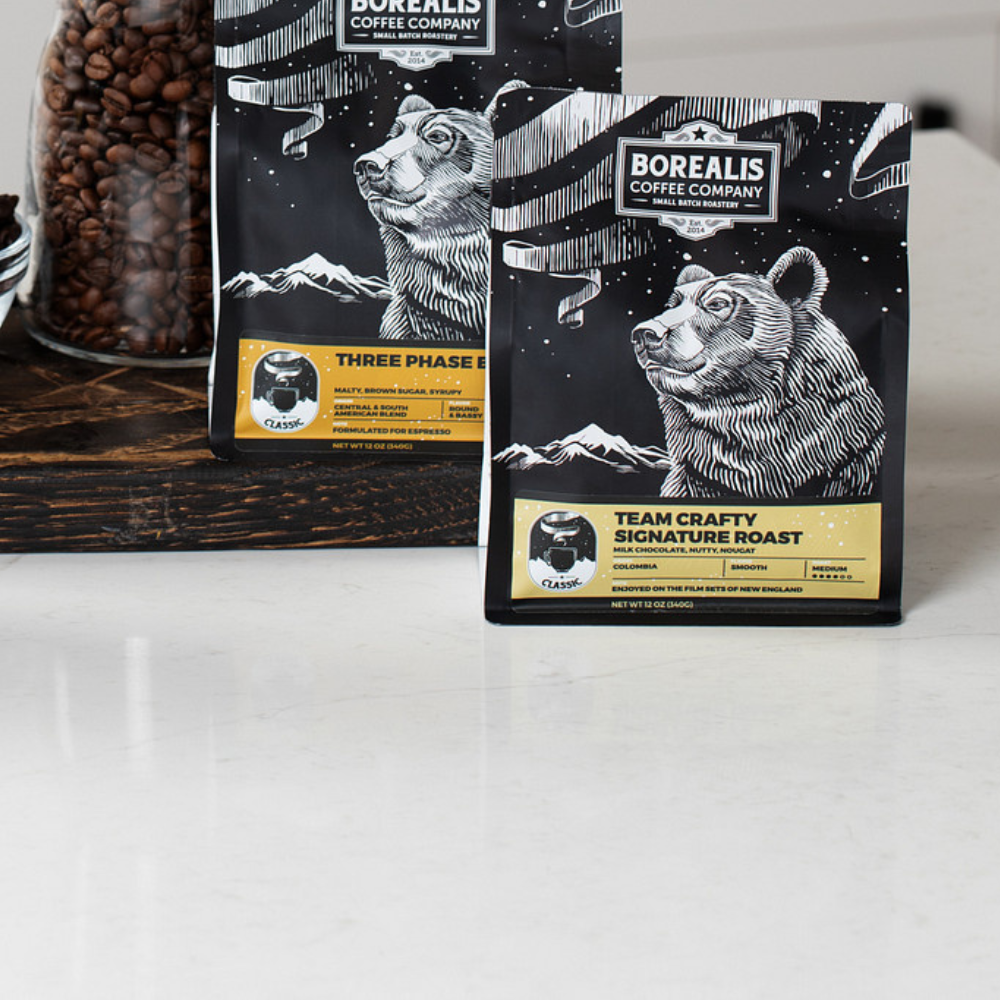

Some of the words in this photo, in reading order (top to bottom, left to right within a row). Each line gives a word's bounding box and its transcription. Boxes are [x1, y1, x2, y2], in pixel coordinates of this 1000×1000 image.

[350, 16, 405, 29] COFFEE
[408, 17, 481, 31] COMPANY
[373, 32, 396, 40] SMALL
[398, 32, 421, 40] BATCH
[422, 33, 458, 41] ROASTERY
[630, 153, 765, 181] BOREALIS
[630, 180, 685, 195] COFFEE
[689, 183, 763, 199] COMPANY
[652, 198, 676, 206] SMALL
[678, 199, 701, 207] BATCH
[702, 200, 739, 209] ROASTERY
[336, 353, 401, 367] THREE
[406, 355, 472, 369] PHASE
[334, 387, 363, 395] MALTY,
[264, 418, 304, 429] CLASSIC
[614, 512, 672, 525] TEAM
[676, 512, 758, 527] CRAFTY
[614, 529, 730, 543] SIGNATURE
[734, 531, 803, 545] ROAST
[542, 578, 582, 589] CLASSIC
[667, 601, 694, 609] (340G)
